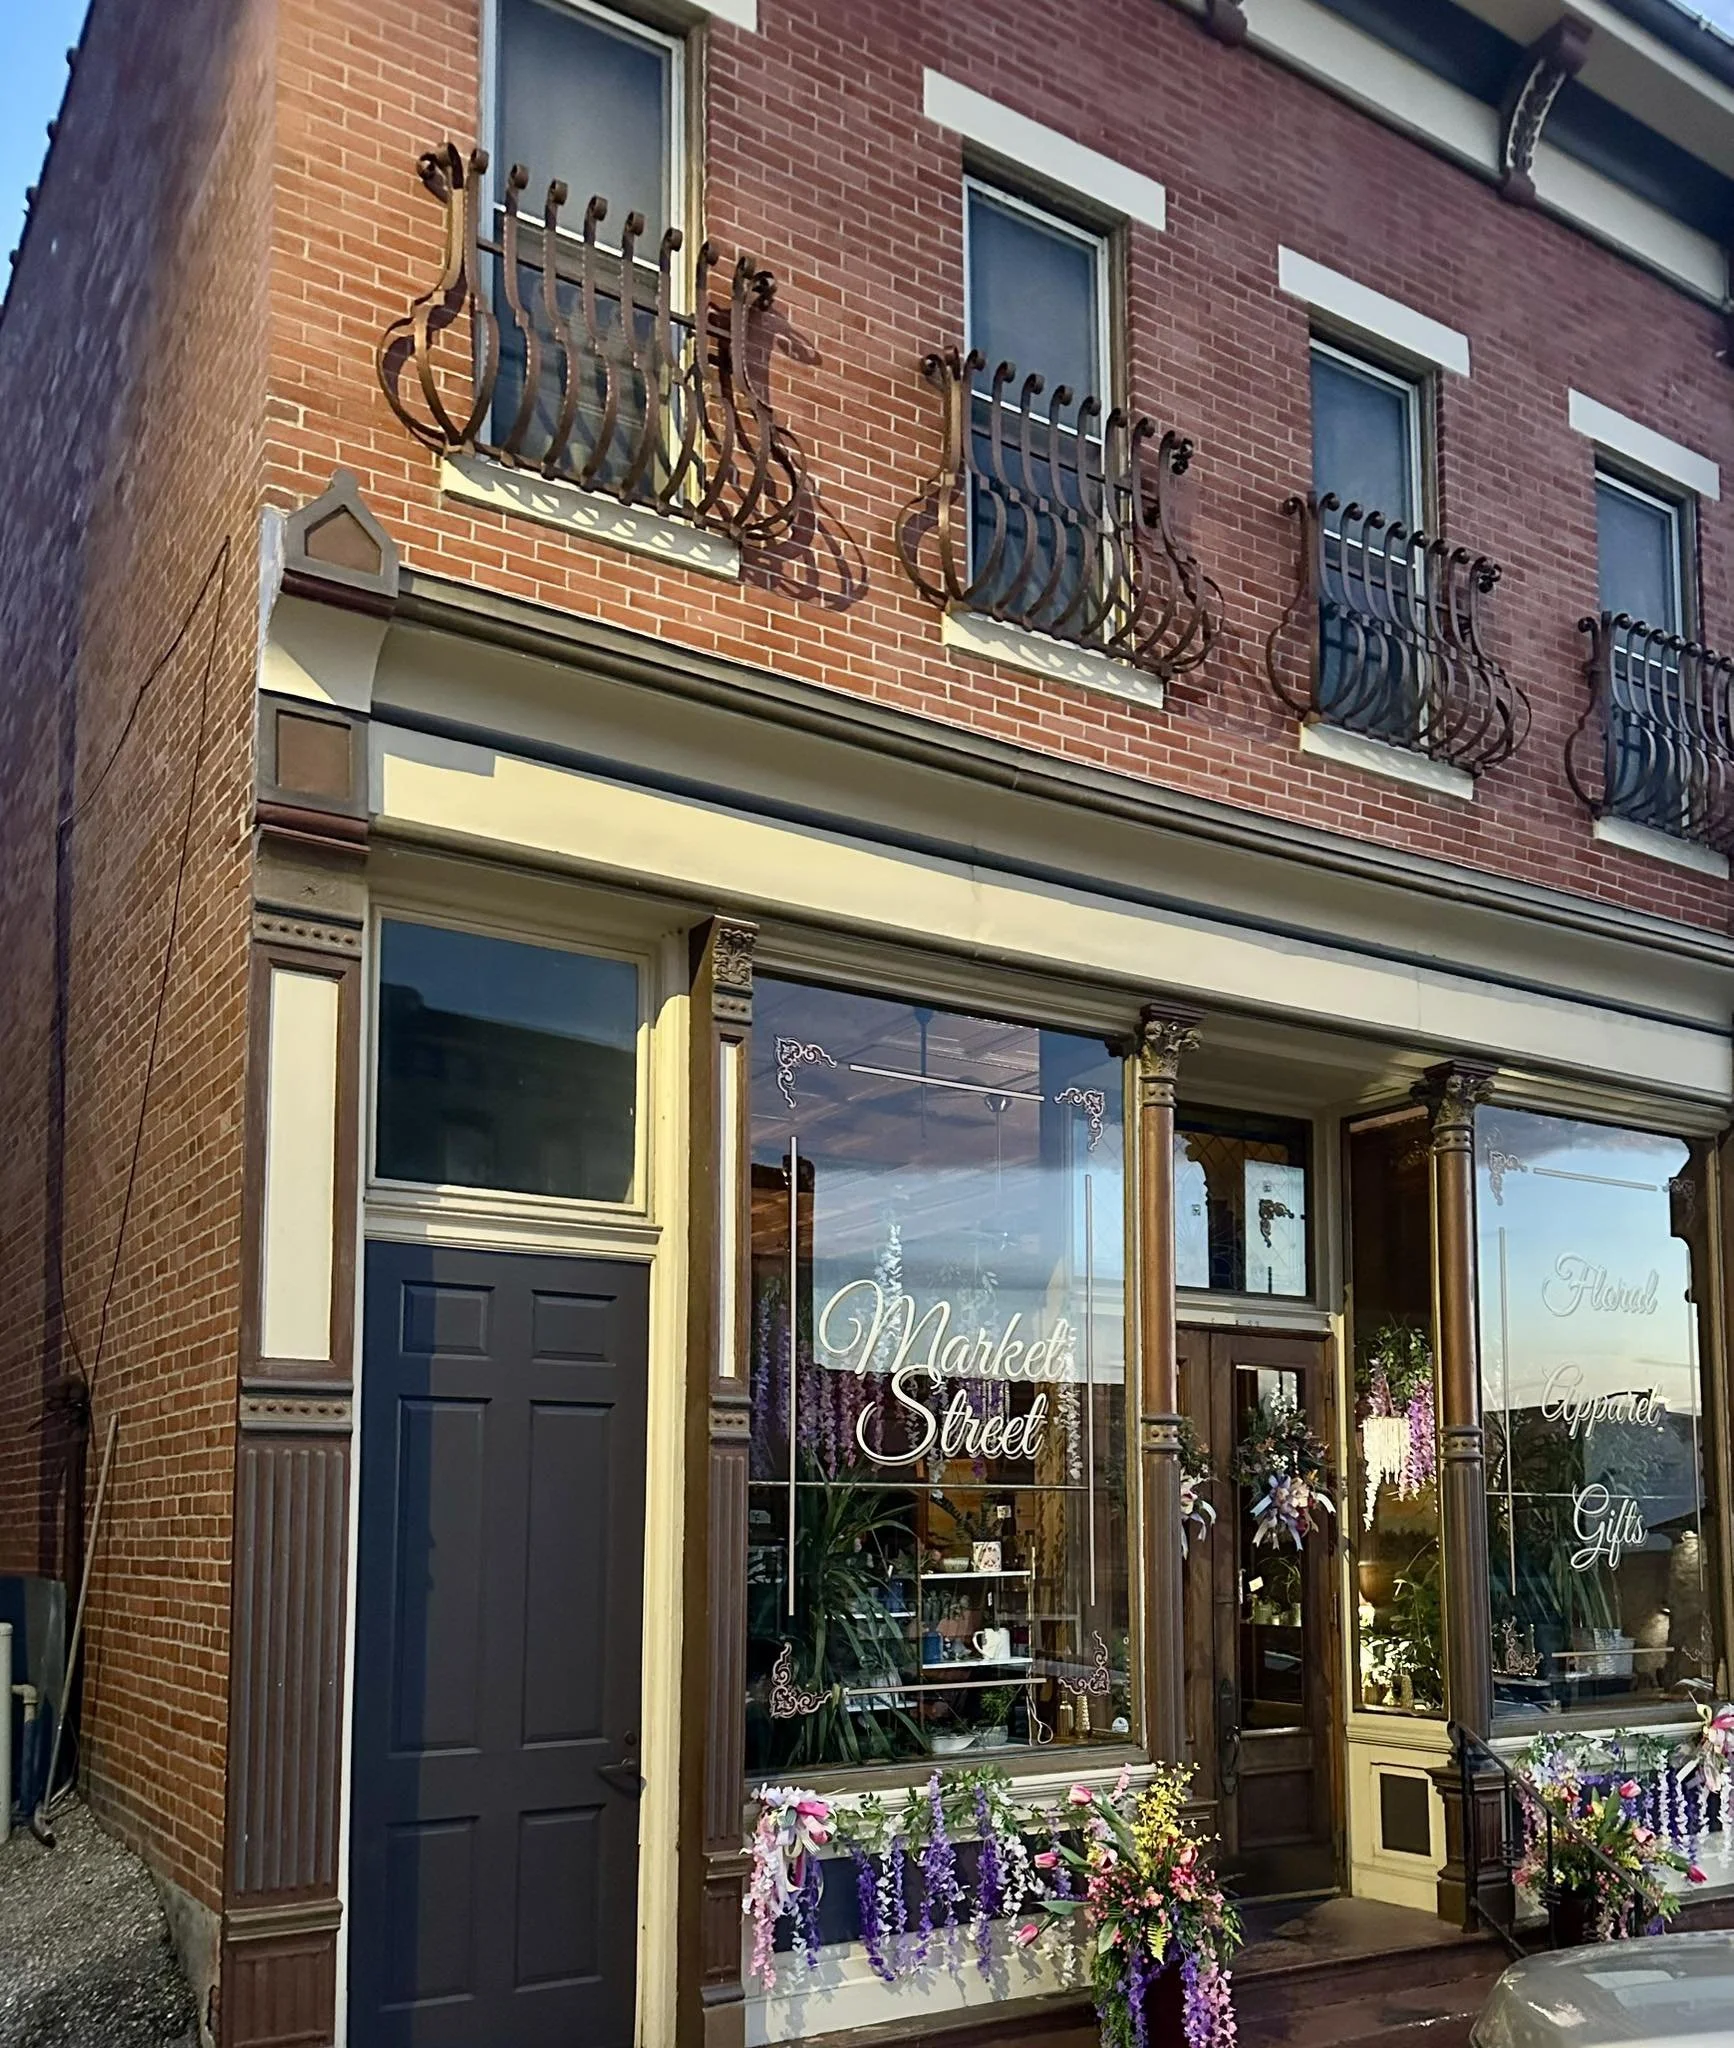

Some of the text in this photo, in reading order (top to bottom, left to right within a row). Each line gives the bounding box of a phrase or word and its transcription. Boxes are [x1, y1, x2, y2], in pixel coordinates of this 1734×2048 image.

[818, 1279, 1068, 1379] Market
[1541, 1252, 1660, 1317] Floral
[855, 1364, 1048, 1465] Street
[1541, 1360, 1662, 1439] Apparel
[1570, 1481, 1649, 1571] Gifts
